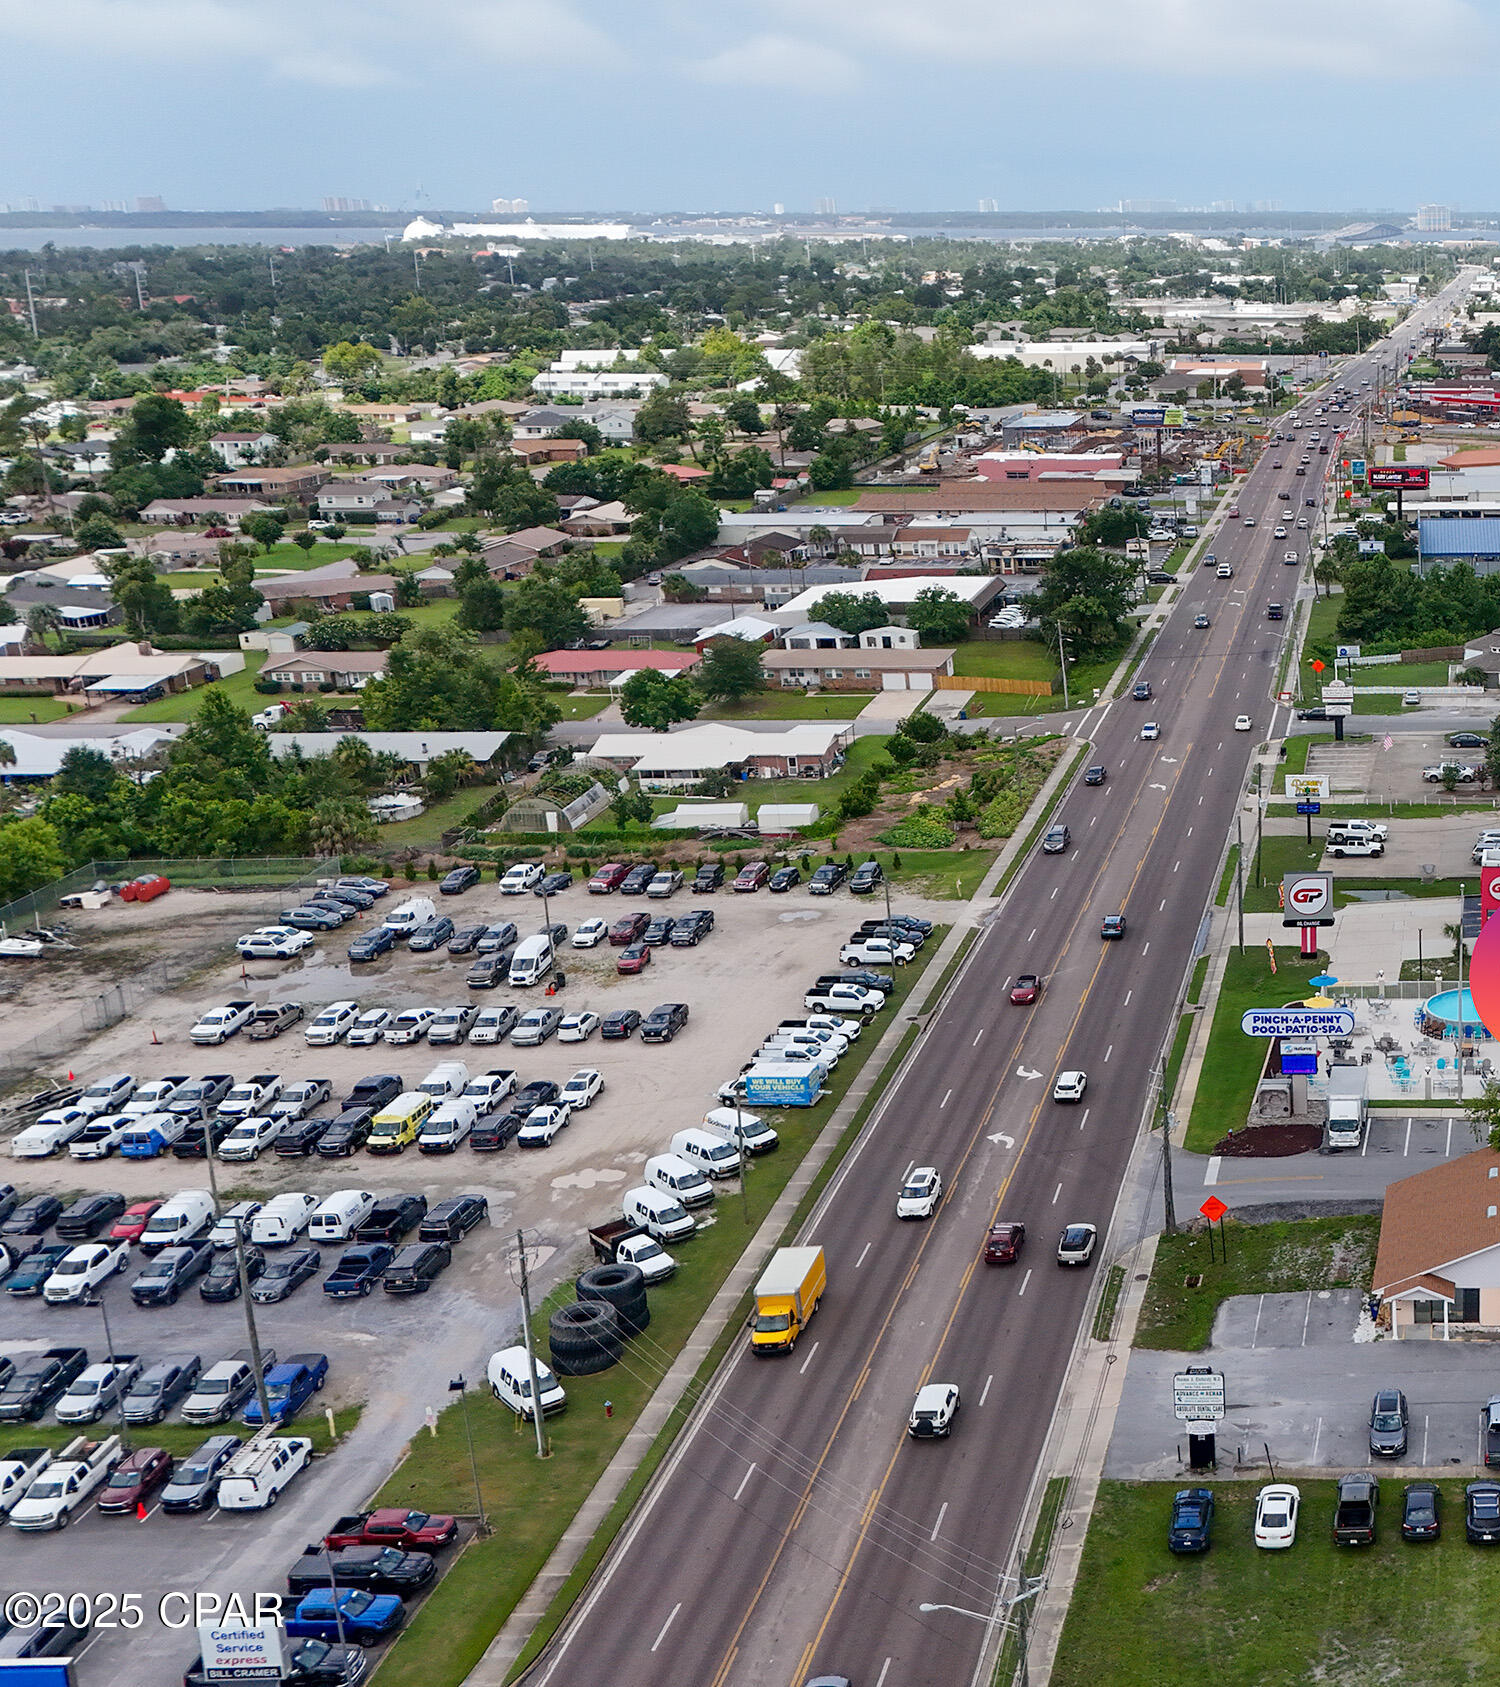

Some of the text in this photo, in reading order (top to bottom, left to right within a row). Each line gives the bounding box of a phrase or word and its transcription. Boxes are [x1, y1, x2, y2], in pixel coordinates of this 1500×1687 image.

[1293, 888, 1323, 903] GP
[210, 1630, 265, 1640] Certified
[215, 1643, 264, 1653] Service
[215, 1656, 268, 1666] express
[209, 1668, 279, 1678] BILL CRAMER
